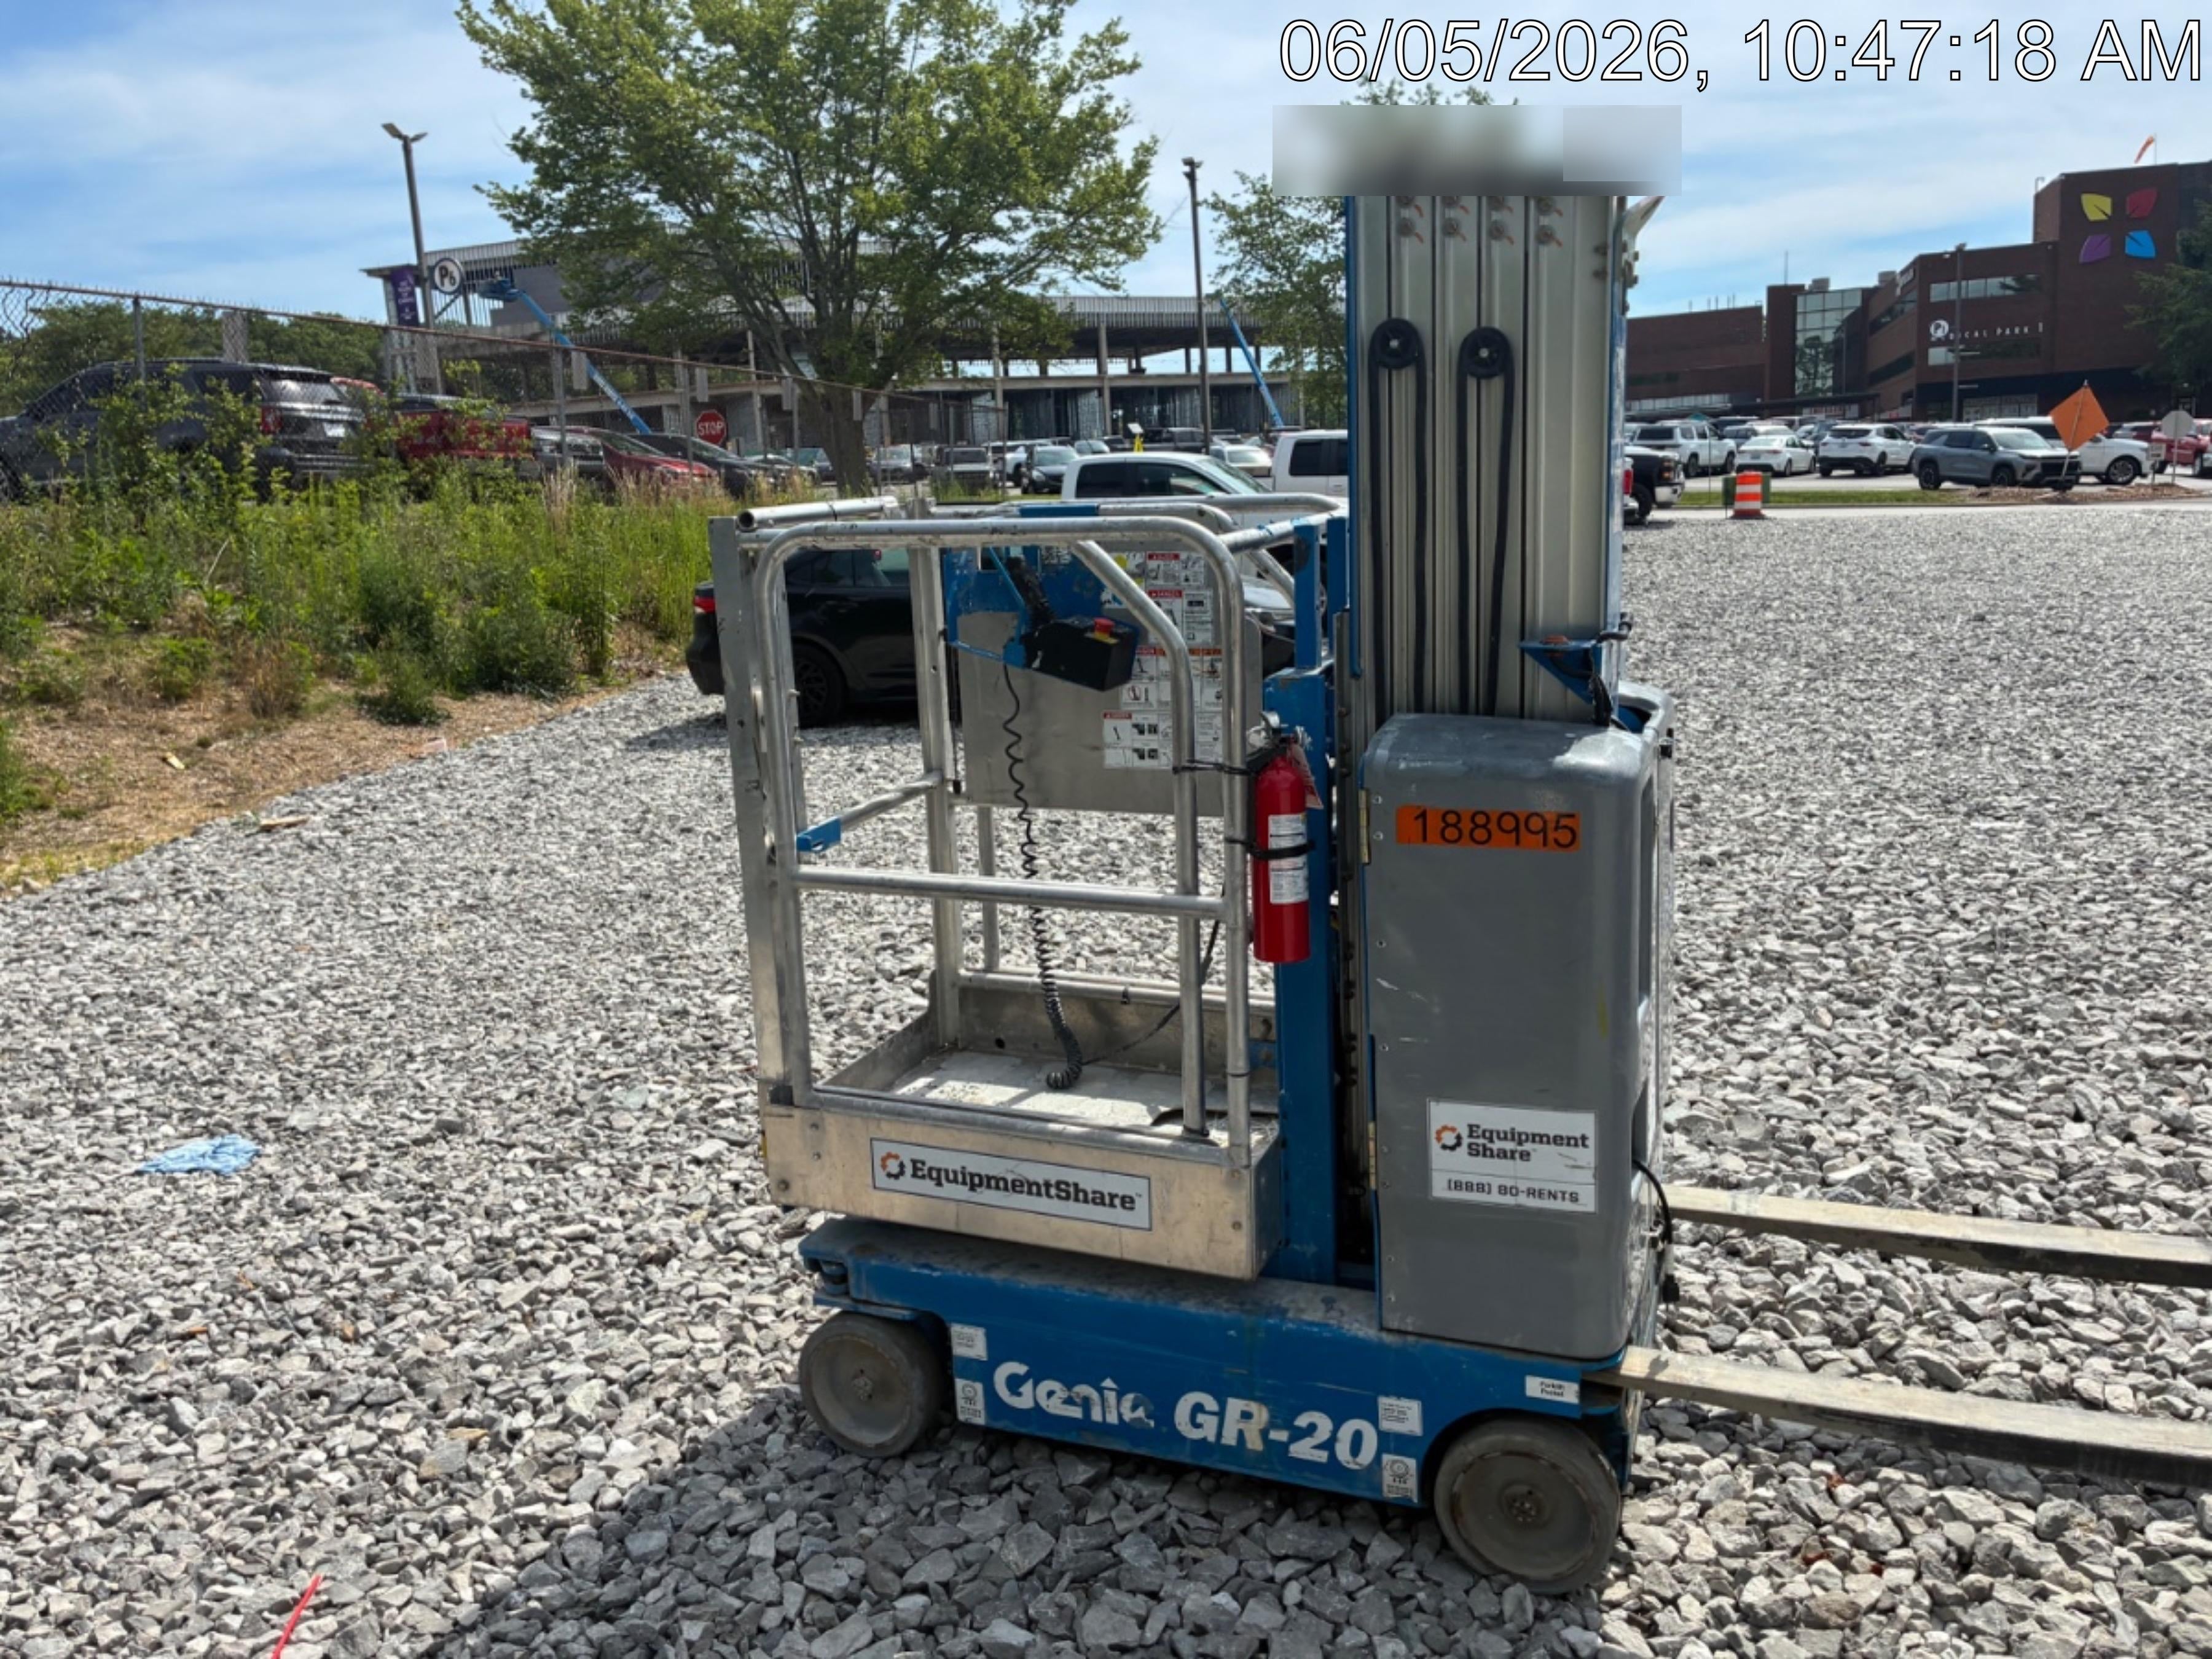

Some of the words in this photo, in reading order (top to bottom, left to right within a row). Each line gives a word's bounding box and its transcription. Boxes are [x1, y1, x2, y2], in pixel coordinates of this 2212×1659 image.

[697, 421, 724, 437] STOP
[1413, 807, 1578, 849] 188995
[1467, 1123, 1590, 1148] Equipment
[1174, 1390, 1378, 1470] GR-20
